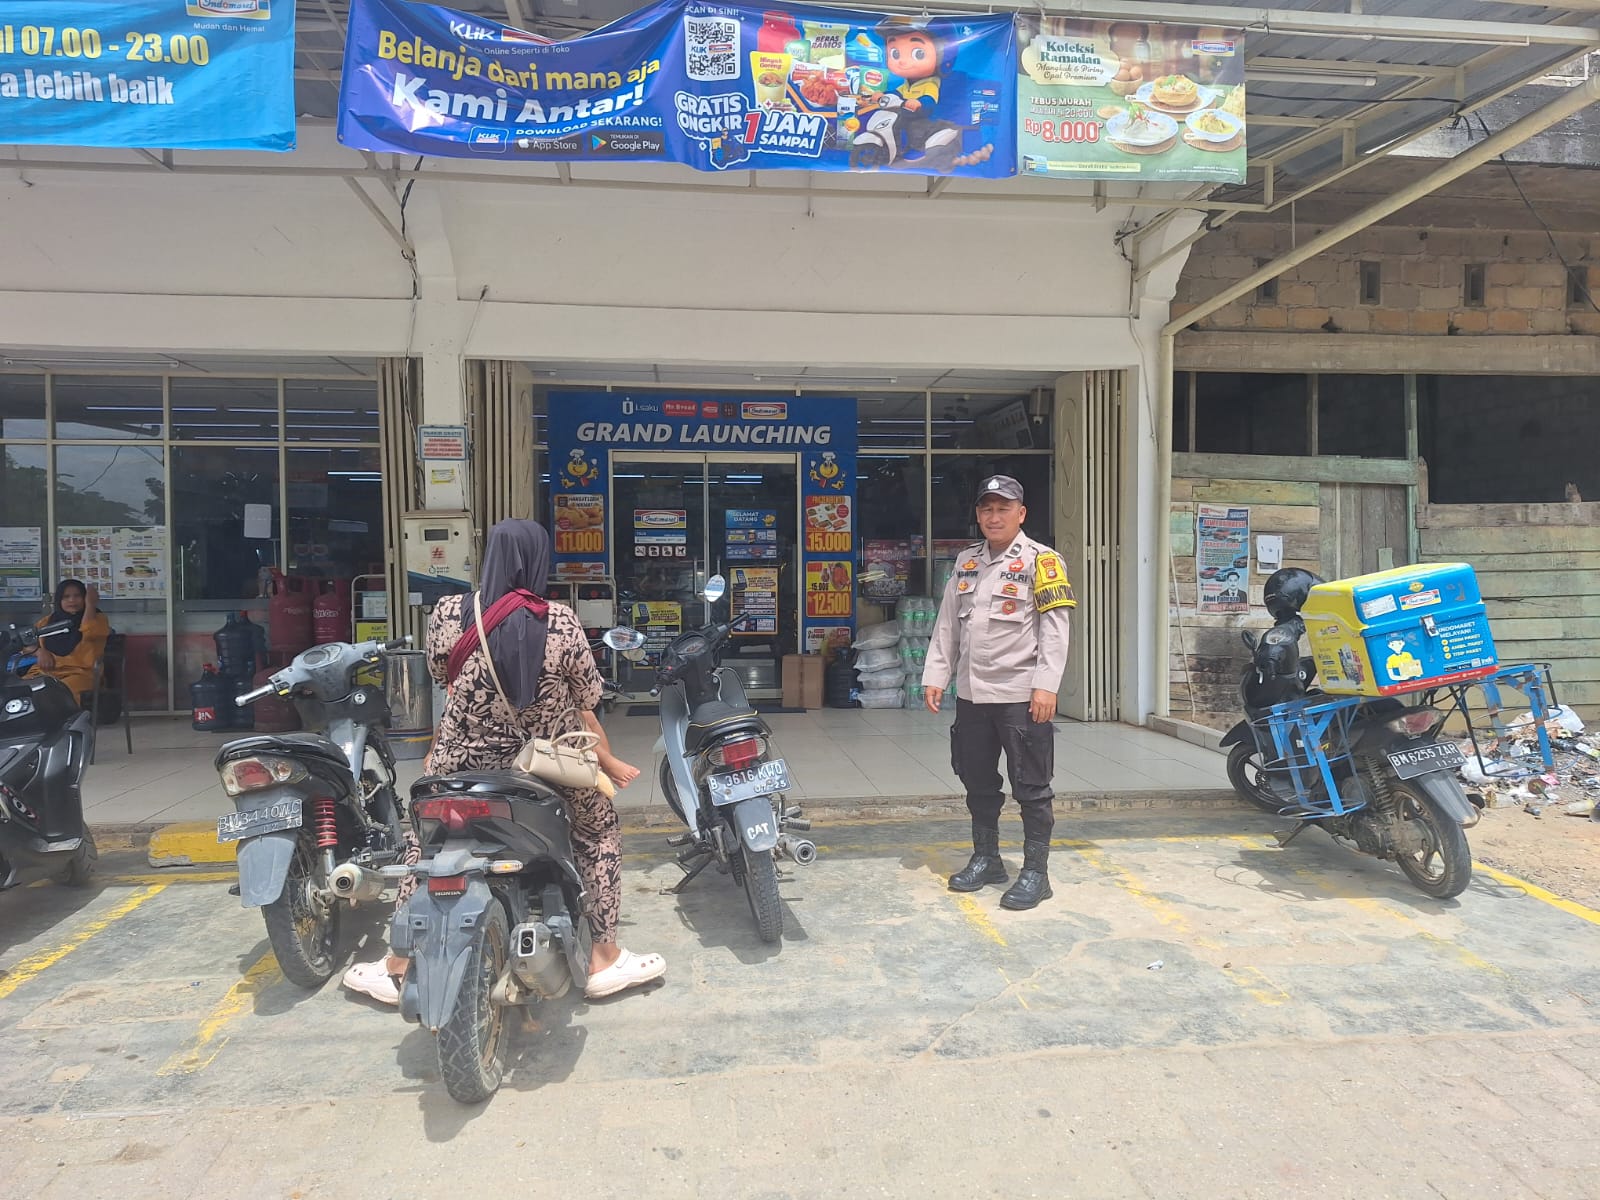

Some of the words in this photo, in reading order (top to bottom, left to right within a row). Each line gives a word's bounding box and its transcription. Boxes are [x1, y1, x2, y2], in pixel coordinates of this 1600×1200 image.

[718, 7, 739, 16] SINI!
[221, 23, 238, 32] dan
[20, 25, 101, 59] 07.00
[125, 31, 209, 66] 23.00
[551, 45, 570, 54] Toko
[1046, 41, 1095, 54] Koleksi
[378, 29, 481, 81] Belanja
[487, 60, 539, 90] dari
[545, 69, 622, 90] mana
[626, 59, 660, 83] aja
[1040, 51, 1101, 65] Ramadan
[24, 68, 104, 102] lebih
[108, 72, 175, 104] baik
[392, 71, 508, 122] Kami
[514, 82, 645, 124] Antar!
[677, 93, 742, 116] GRATIS
[1030, 96, 1057, 106] TEBUS
[1058, 98, 1093, 107] MURAH
[516, 122, 588, 136] DOWNLOAD
[590, 116, 663, 127] SEKARANG!
[678, 111, 742, 134] ONGKIR
[744, 111, 762, 144] 1
[763, 110, 821, 137] JAM
[533, 141, 552, 150] App
[553, 141, 578, 150] Store
[610, 141, 641, 152] Google
[642, 141, 660, 151] Play
[759, 133, 816, 149] SAMPAI
[576, 422, 673, 443] GRAND
[679, 424, 831, 445] LAUNCHING
[1000, 571, 1028, 583] POLRI
[1390, 755, 1409, 767] BM
[1408, 748, 1436, 763] 6255
[1435, 743, 1458, 756] ZAR
[710, 777, 719, 790] B
[725, 769, 754, 788] 3616
[747, 822, 770, 840] CAT
